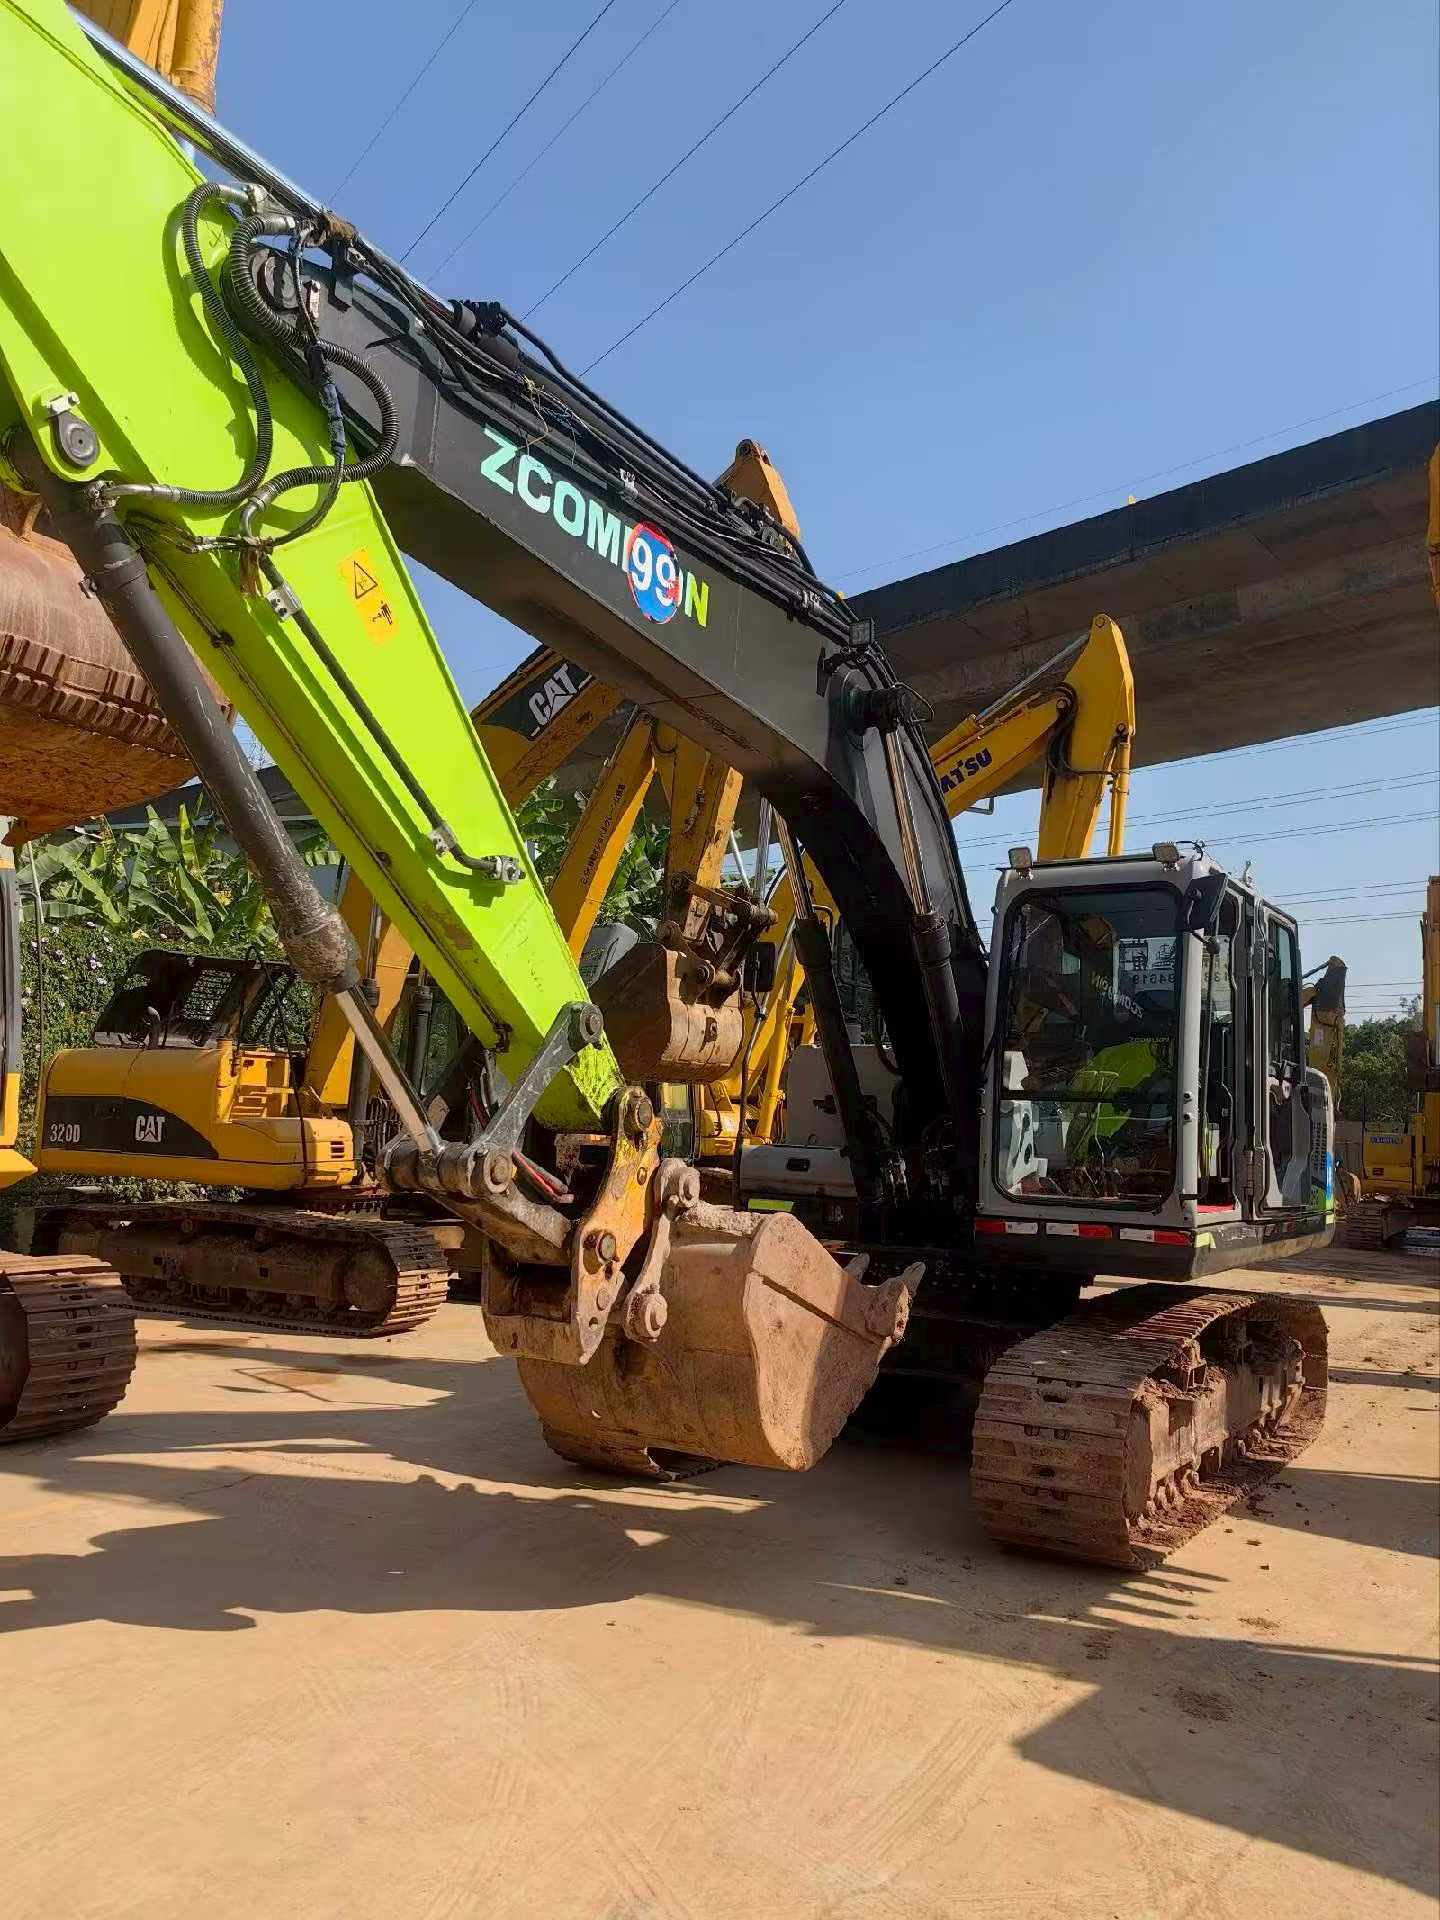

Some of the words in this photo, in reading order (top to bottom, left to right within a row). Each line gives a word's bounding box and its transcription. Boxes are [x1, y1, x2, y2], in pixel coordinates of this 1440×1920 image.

[528, 663, 578, 726] CAT
[49, 1123, 81, 1143] 320D
[135, 1115, 166, 1143] CAT
